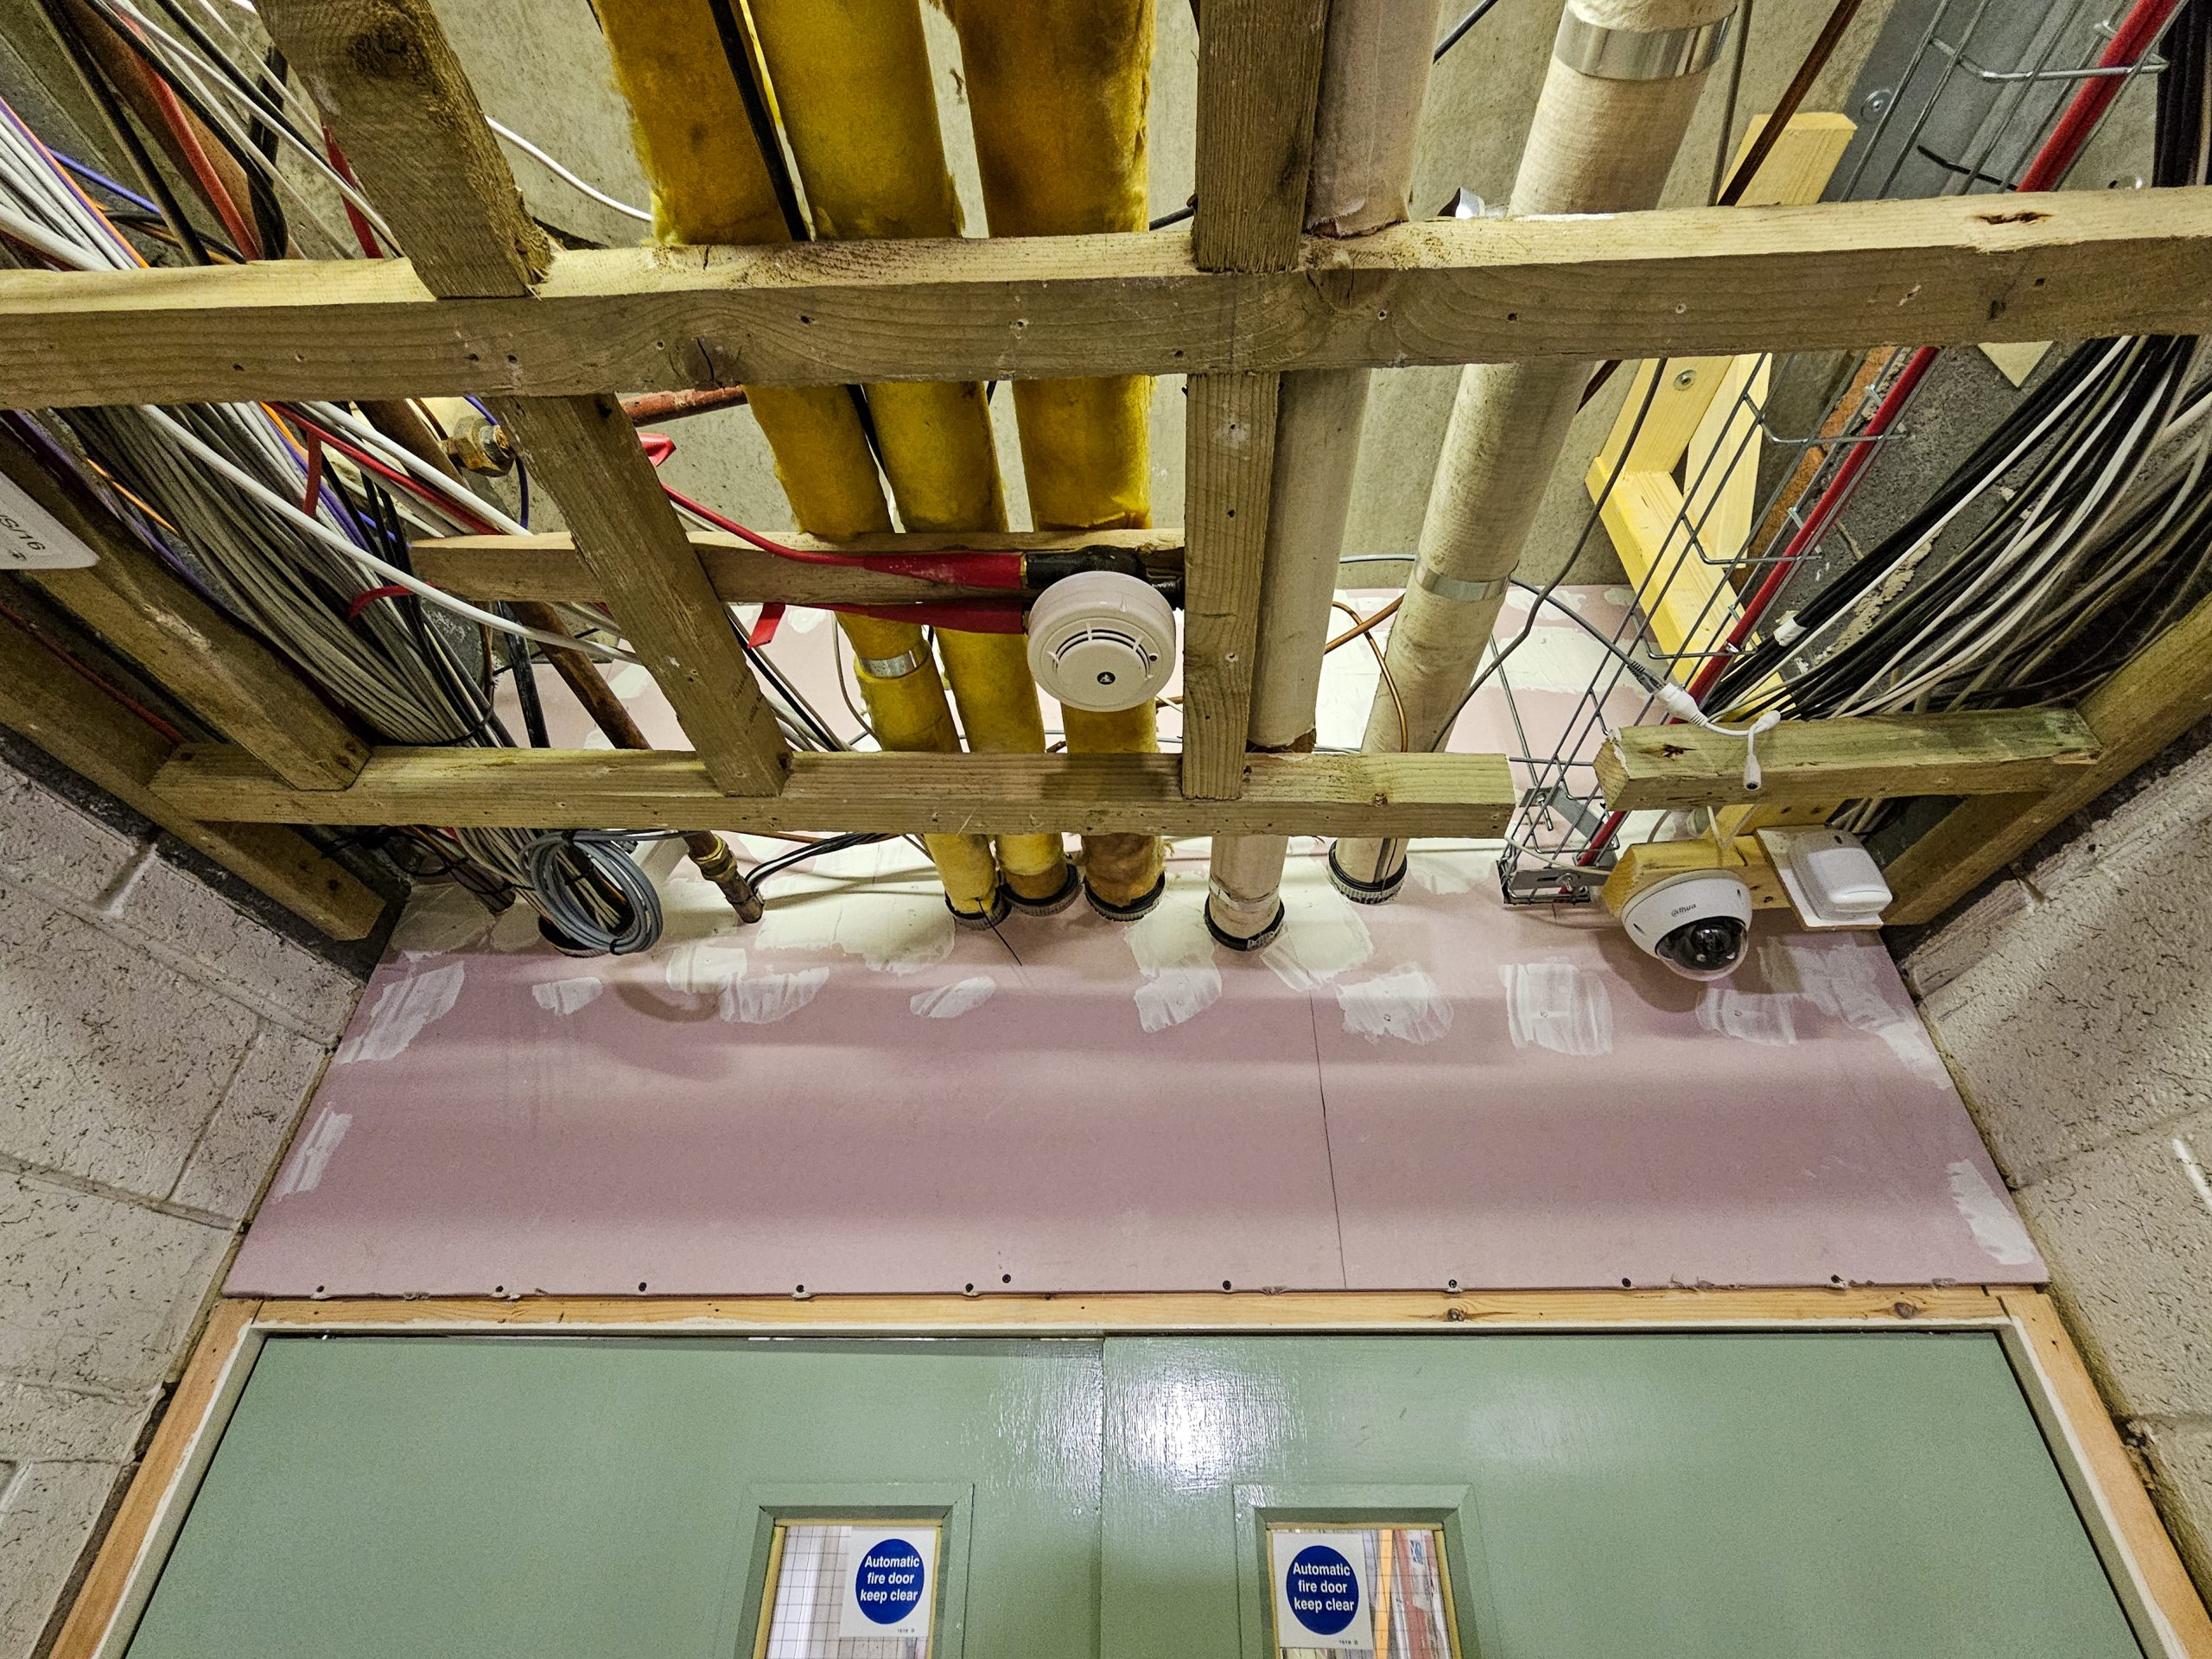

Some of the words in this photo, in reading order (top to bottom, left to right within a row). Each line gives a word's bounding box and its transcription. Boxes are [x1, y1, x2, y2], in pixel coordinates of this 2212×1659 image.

[864, 1554, 920, 1568] Automatic
[1293, 1561, 1351, 1576] Automatic
[867, 1571, 886, 1585] fire
[887, 1571, 915, 1585] door
[1298, 1579, 1318, 1592] fire
[1320, 1580, 1348, 1593] door
[860, 1588, 887, 1605] keep
[890, 1588, 918, 1602] clear
[1294, 1596, 1323, 1614] keep
[1325, 1597, 1355, 1611] clear
